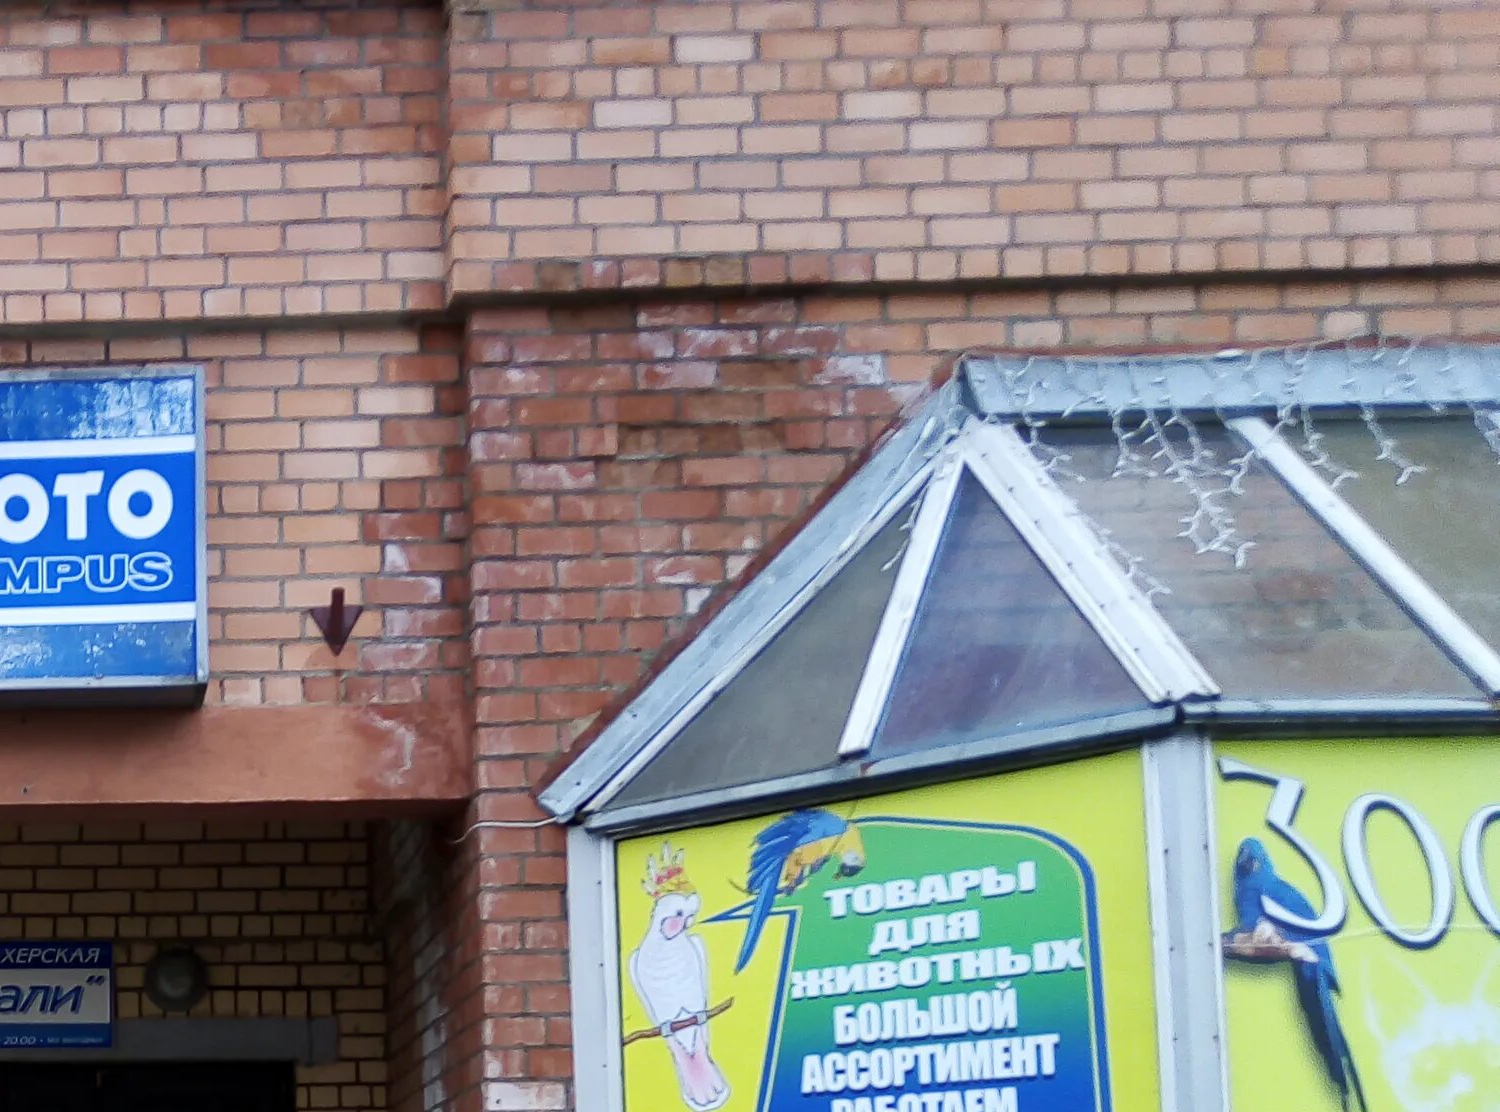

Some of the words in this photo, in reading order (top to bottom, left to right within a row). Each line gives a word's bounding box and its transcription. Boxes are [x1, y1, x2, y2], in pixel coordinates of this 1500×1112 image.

[822, 860, 1037, 918] ТОВАРЫ
[868, 909, 981, 956] ДЛЯ
[790, 937, 1086, 1000] ЖИВОТНЫХ
[833, 980, 1019, 1046] БОЛЬШОЙ
[801, 1033, 1061, 1095] АССОРТИМЕНТ
